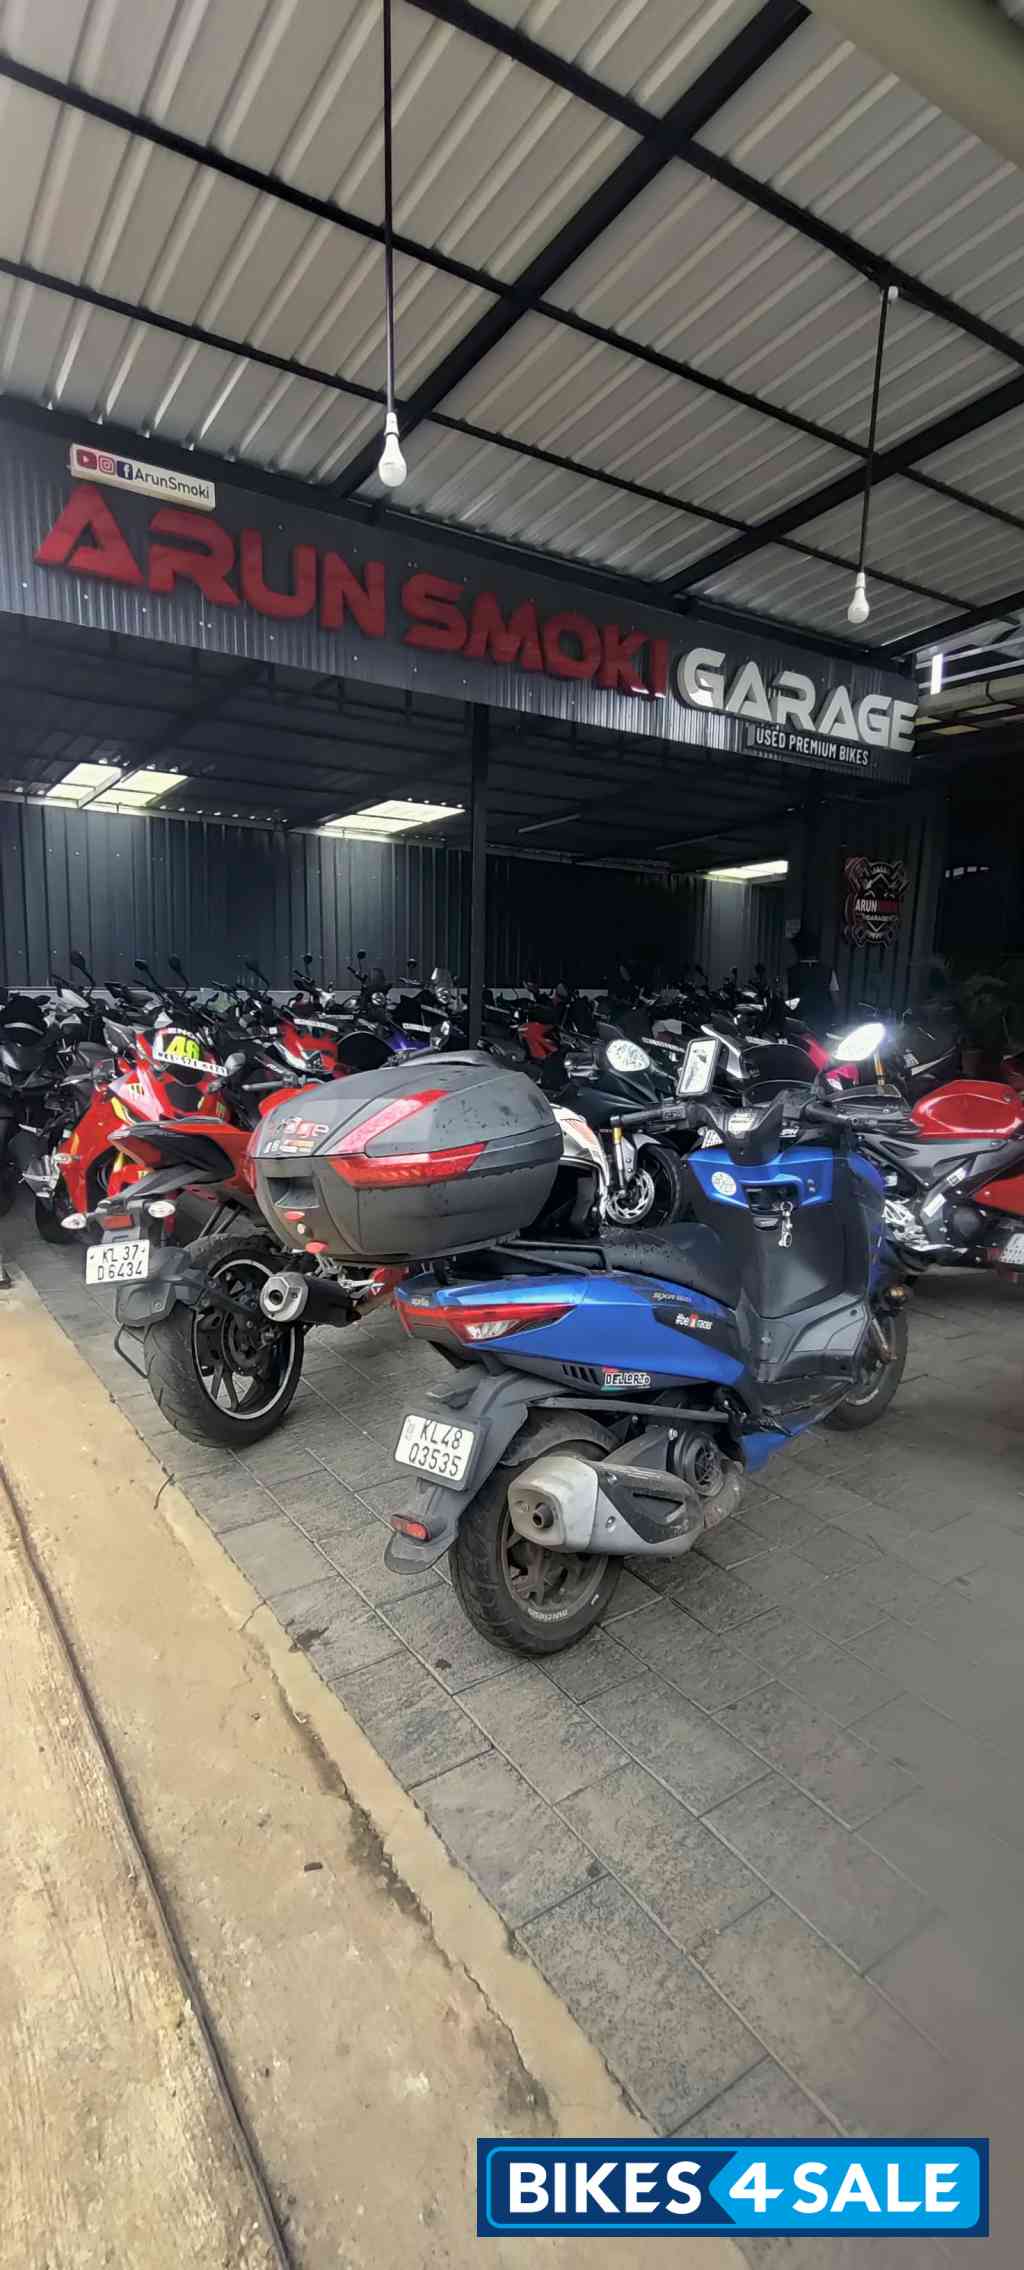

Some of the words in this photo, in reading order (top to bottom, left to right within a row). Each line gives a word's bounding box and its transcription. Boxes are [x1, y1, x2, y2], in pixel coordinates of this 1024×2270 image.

[134, 468, 210, 500] ArunSmoki
[34, 485, 386, 638] ARUN
[400, 571, 669, 699] SMOKI
[677, 646, 918, 753] GARAGE
[756, 727, 786, 749] USED
[788, 734, 837, 759] PREMIUM
[839, 745, 869, 766] BIKES
[855, 898, 878, 913] ARUN
[122, 1244, 139, 1261] 37
[407, 1442, 462, 1477] 03535
